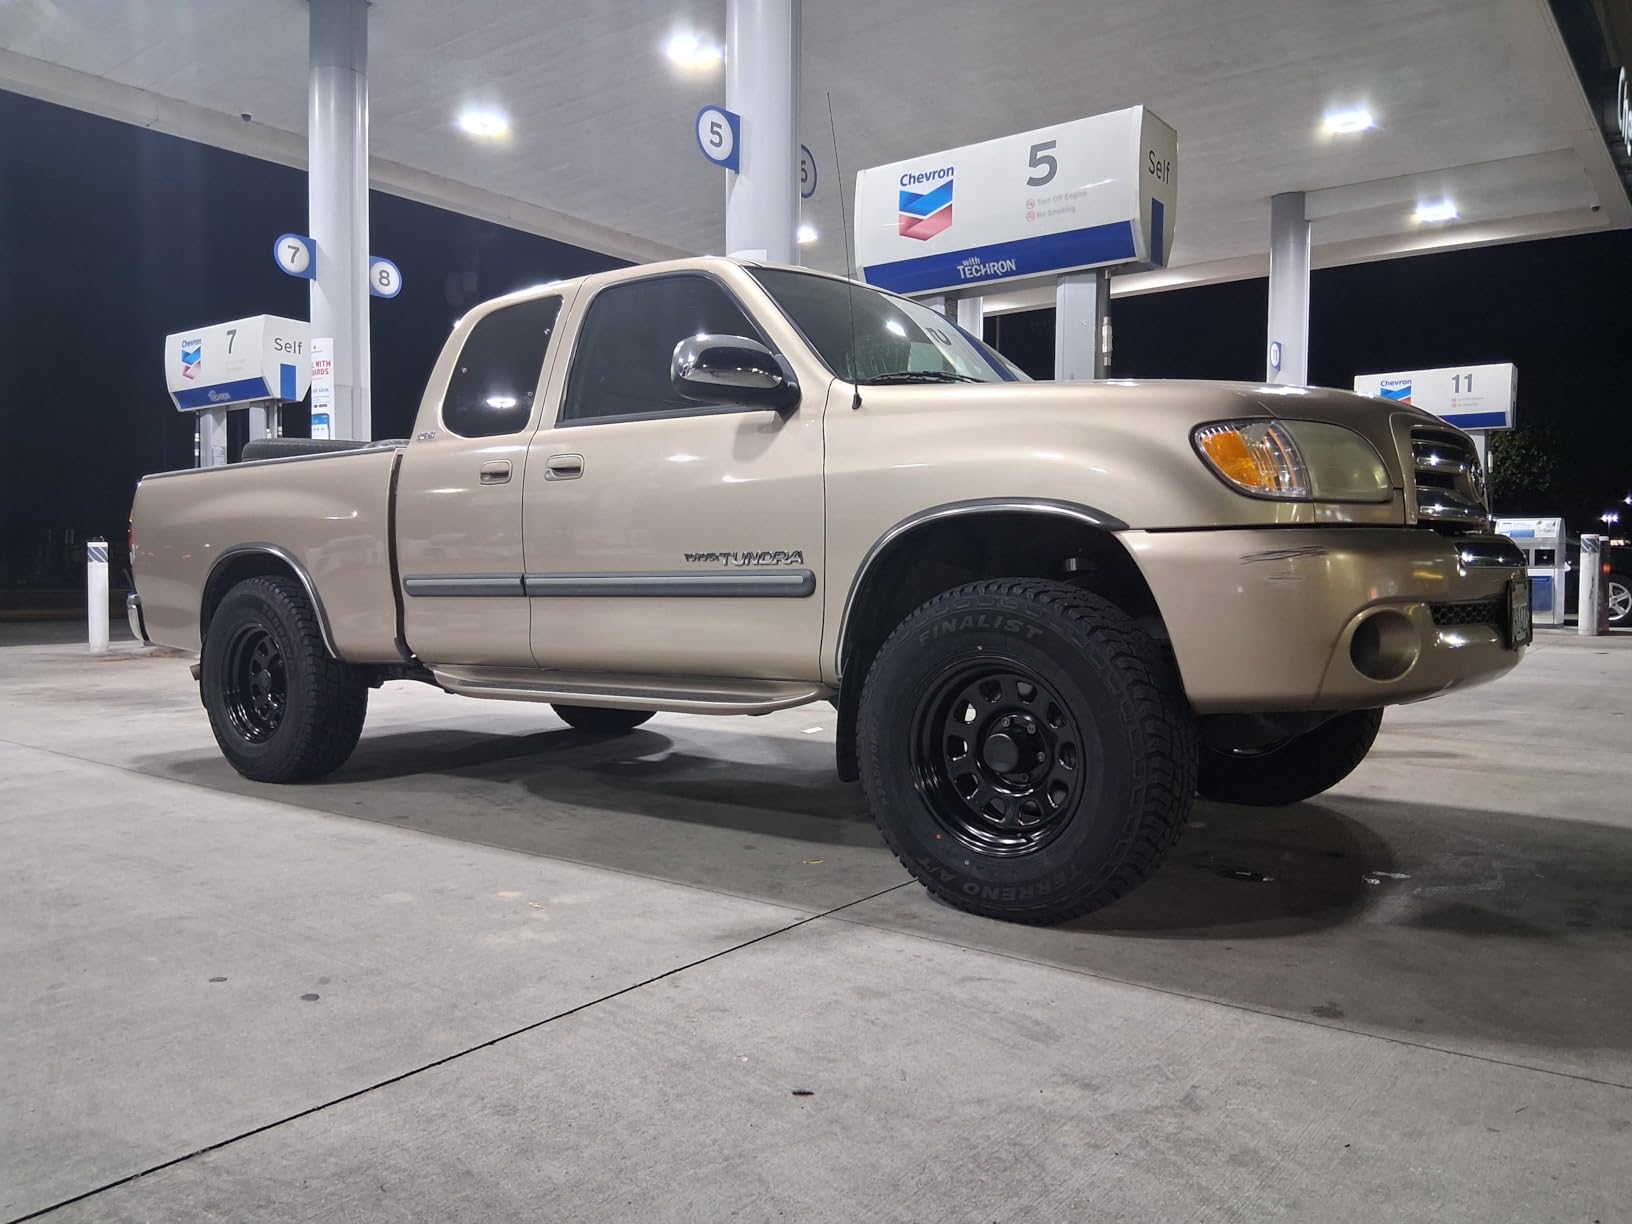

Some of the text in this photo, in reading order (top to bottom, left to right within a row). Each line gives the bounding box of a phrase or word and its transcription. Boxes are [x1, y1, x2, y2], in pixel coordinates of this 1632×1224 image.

[709, 121, 723, 148] 5
[1026, 140, 1058, 187] 5
[1147, 149, 1171, 185] Self
[899, 165, 955, 188] Chevron
[286, 245, 300, 264] 7
[962, 255, 981, 267] with
[378, 269, 391, 287] 8
[956, 258, 1016, 281] TECHRON
[181, 337, 202, 349] Chevron
[226, 328, 237, 355] 7
[274, 337, 303, 355] Self
[315, 360, 331, 368] WITH
[1380, 378, 1412, 388] Chevron
[1452, 373, 1473, 394] 11
[717, 550, 804, 567] TUNDRA
[919, 614, 1044, 647] FINALIST
[961, 862, 1084, 901] TERRENO
